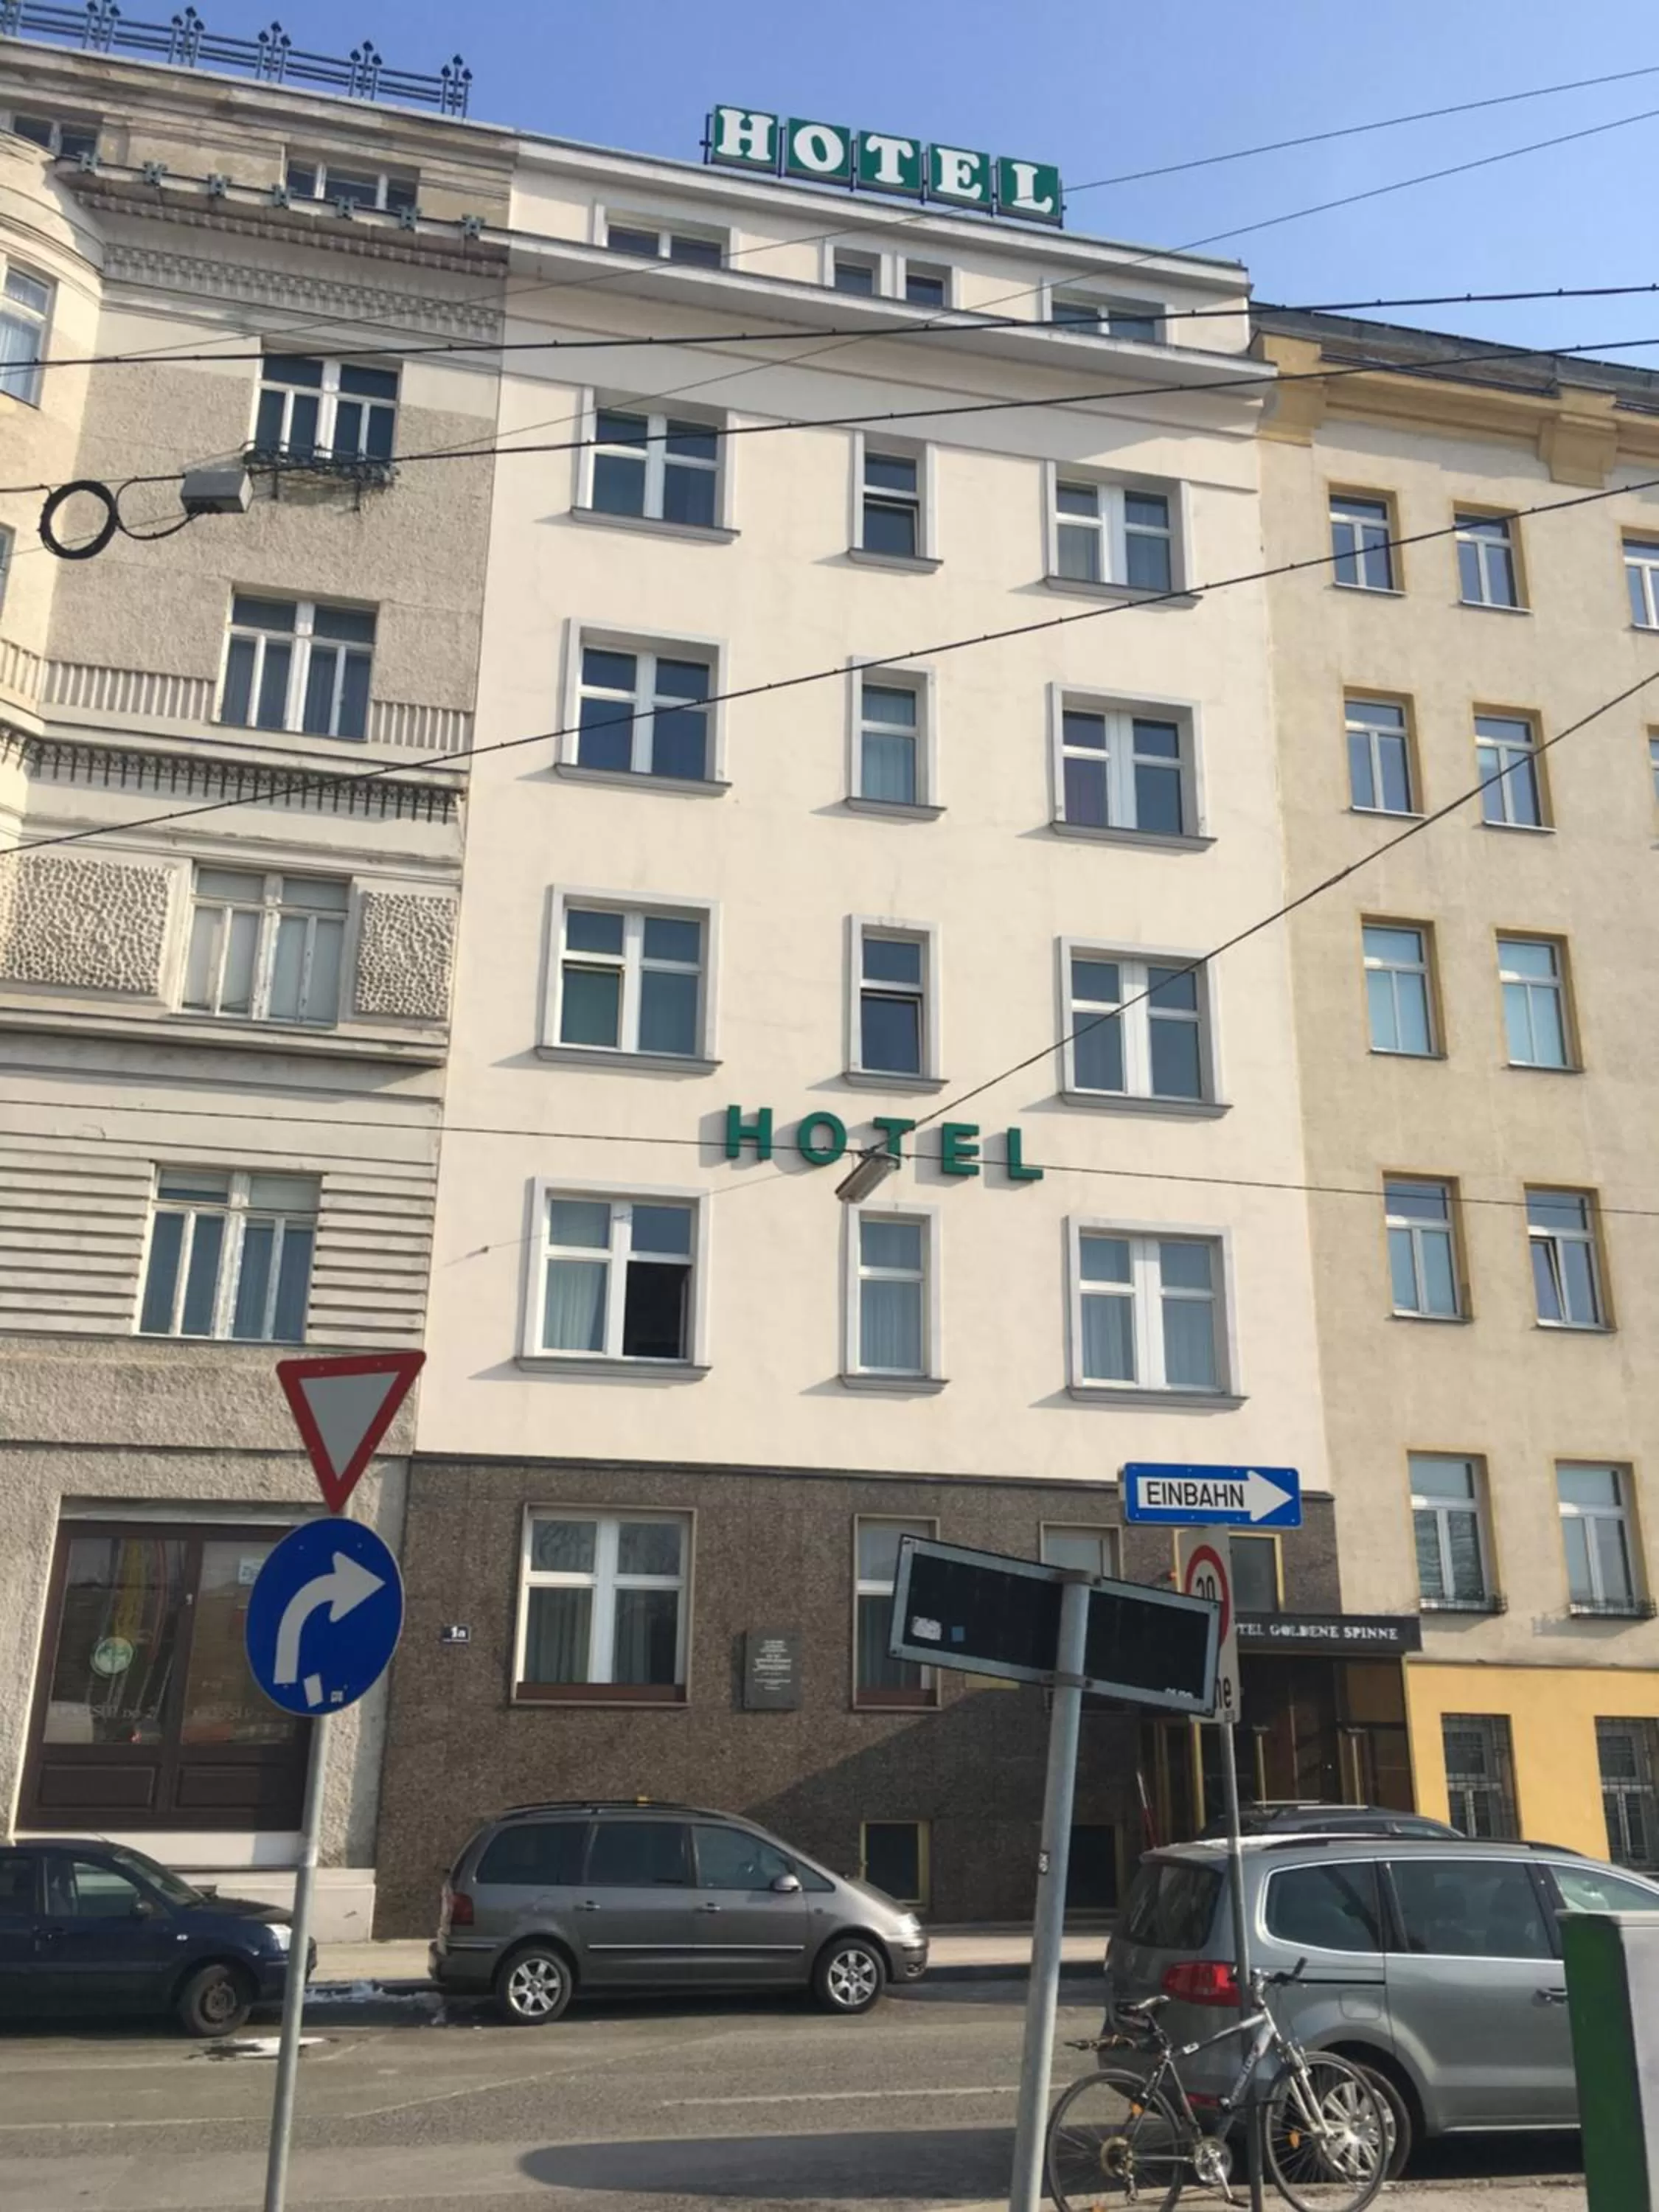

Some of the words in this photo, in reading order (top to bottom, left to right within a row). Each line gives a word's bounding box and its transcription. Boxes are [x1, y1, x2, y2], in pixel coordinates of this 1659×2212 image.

[717, 108, 1054, 214] HOTEL
[725, 1105, 1044, 1180] HOTEL
[1146, 1481, 1245, 1509] EINBAHN
[1237, 1622, 1265, 1636] TEL
[1269, 1624, 1340, 1638] GOLDENE
[1343, 1626, 1399, 1641] SPINNE
